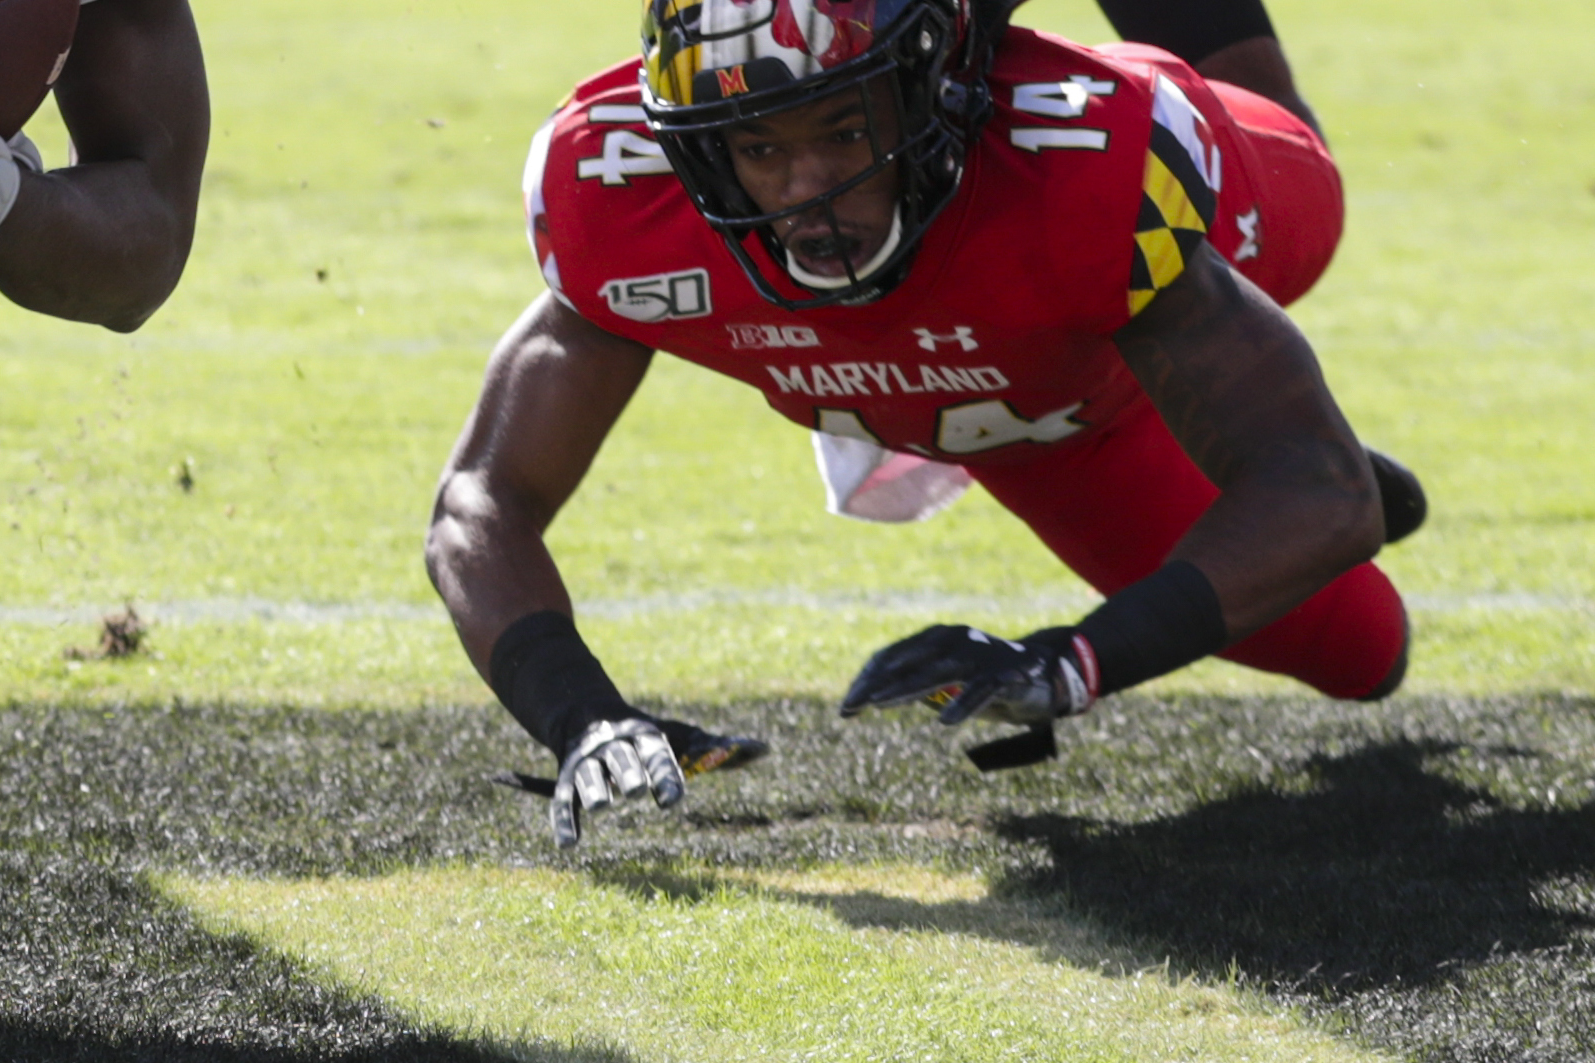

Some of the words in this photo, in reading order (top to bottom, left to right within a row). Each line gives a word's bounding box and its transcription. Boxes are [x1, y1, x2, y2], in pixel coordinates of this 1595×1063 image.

[715, 64, 750, 98] M
[1010, 74, 1117, 154] 14
[576, 103, 676, 187] 14
[603, 270, 710, 322] 150
[766, 361, 1011, 397] MARYLAND
